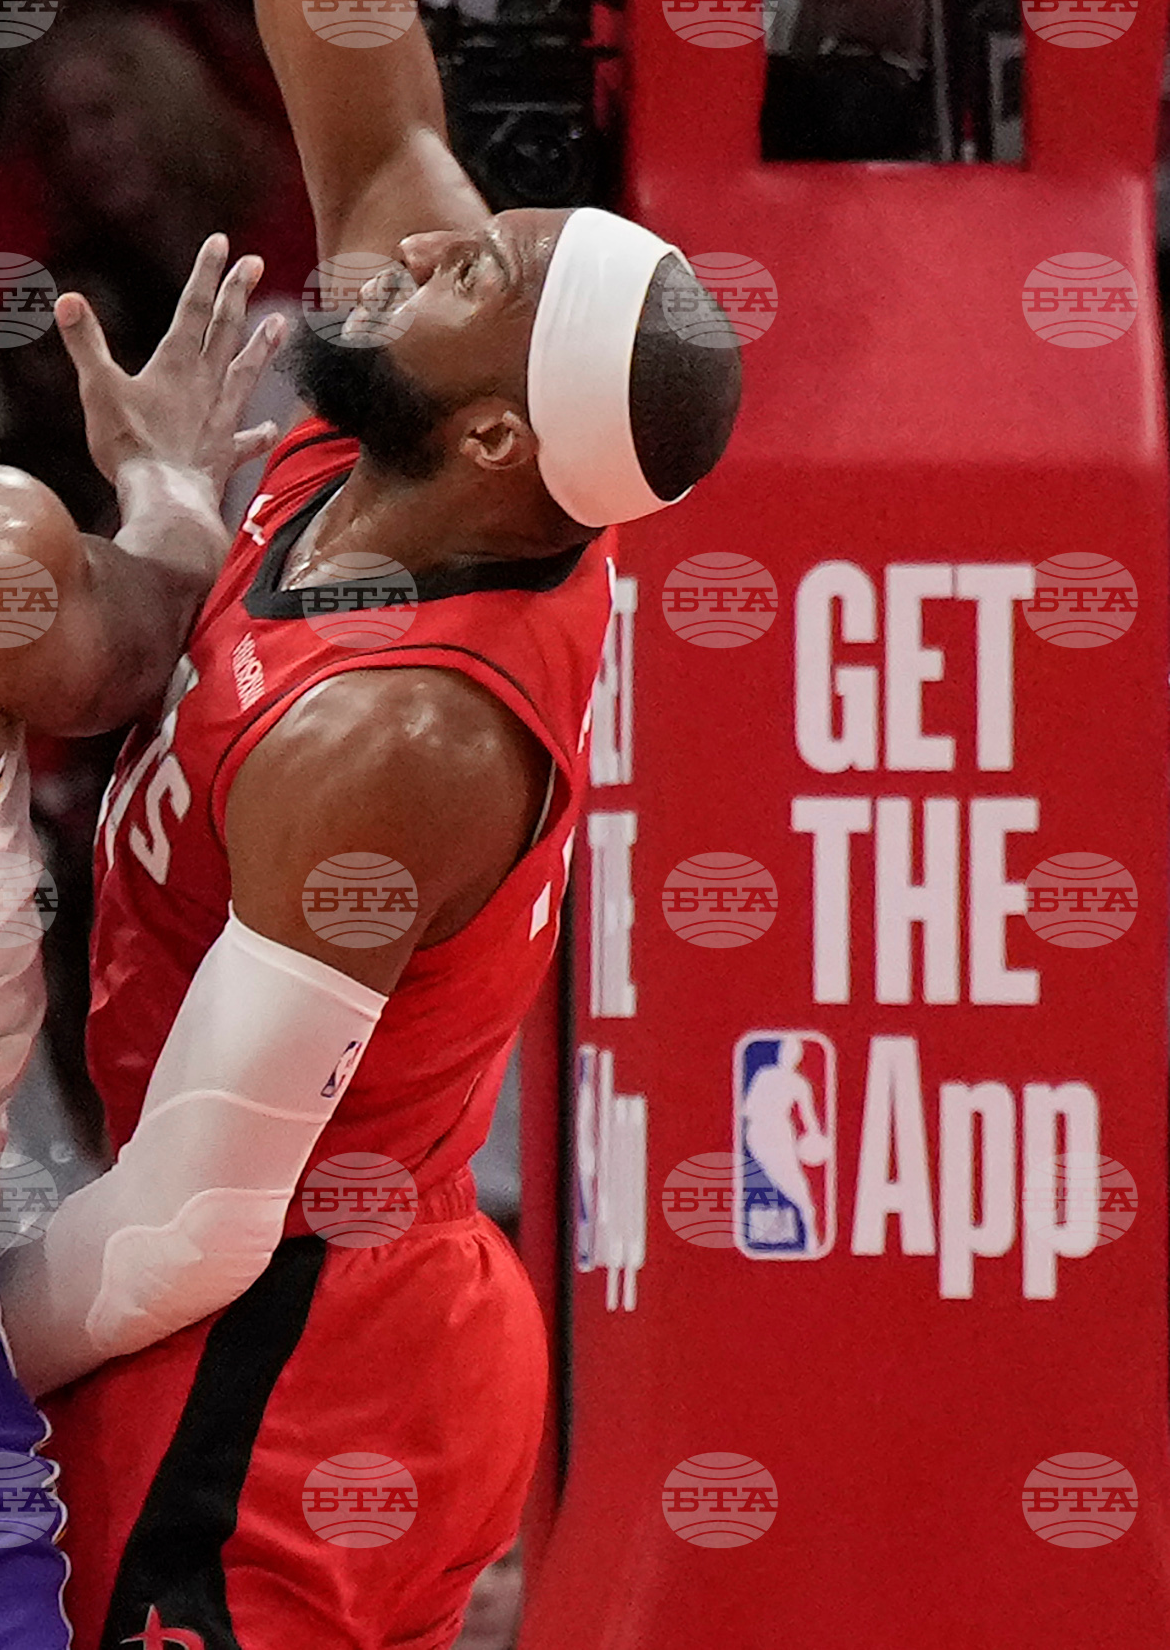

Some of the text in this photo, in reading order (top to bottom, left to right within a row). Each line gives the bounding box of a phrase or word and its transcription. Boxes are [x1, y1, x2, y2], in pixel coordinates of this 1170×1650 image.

[794, 558, 1036, 774] GET
[790, 796, 1041, 1006] THE
[850, 1035, 1101, 1300] App
